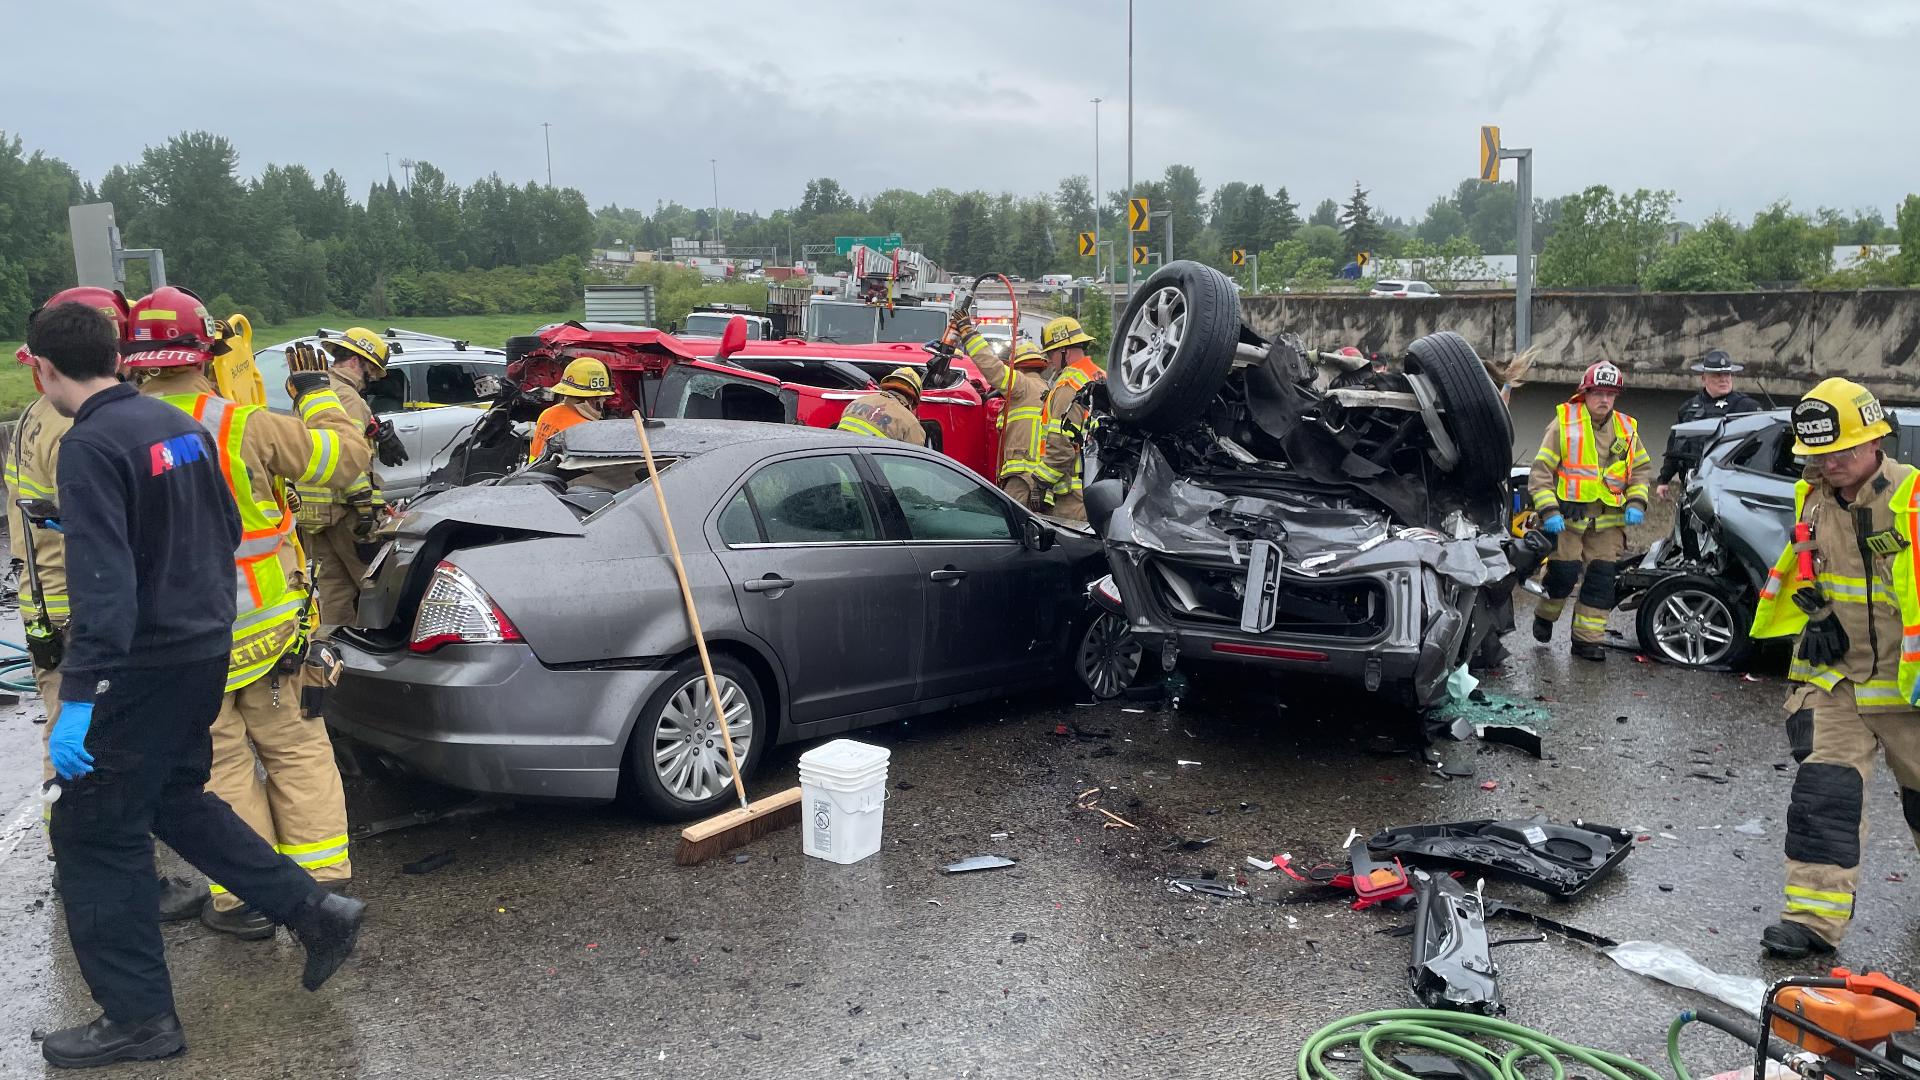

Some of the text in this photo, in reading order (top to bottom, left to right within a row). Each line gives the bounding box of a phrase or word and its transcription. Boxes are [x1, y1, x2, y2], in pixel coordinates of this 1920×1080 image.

[1053, 330, 1067, 341] 56
[359, 338, 375, 352] 55
[123, 350, 197, 364] WILLETTE
[591, 377, 605, 388] 56
[1864, 402, 1882, 423] 39
[230, 631, 280, 668] ETTE
